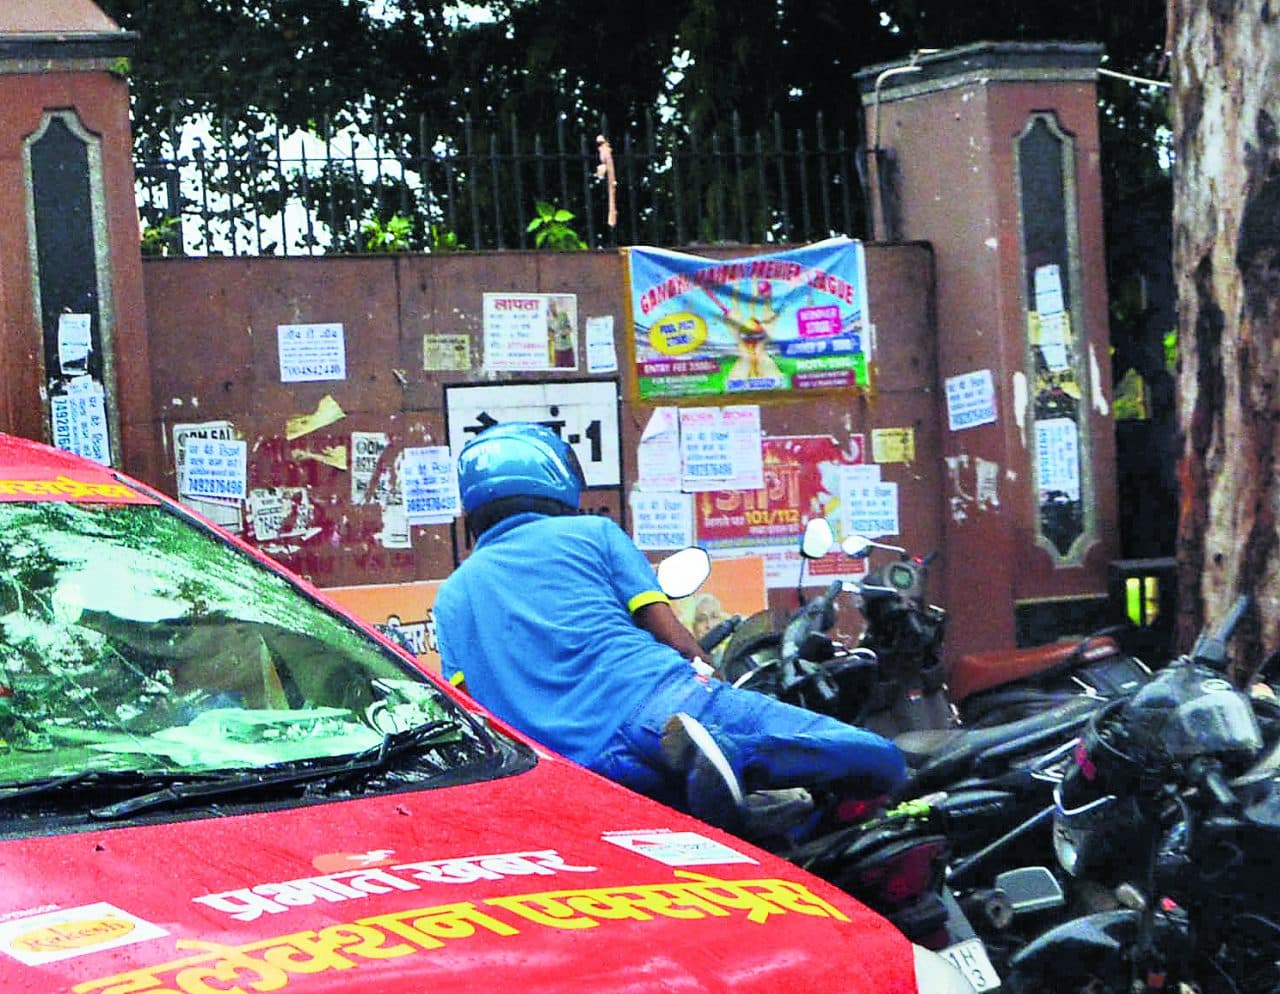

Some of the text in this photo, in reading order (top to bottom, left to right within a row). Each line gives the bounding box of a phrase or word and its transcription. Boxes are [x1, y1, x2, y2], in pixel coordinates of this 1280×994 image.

[494, 299, 541, 312] लापता
[192, 868, 422, 922] प्रभात
[390, 850, 598, 885] खबर
[482, 869, 852, 930] एक्सप्रेस
